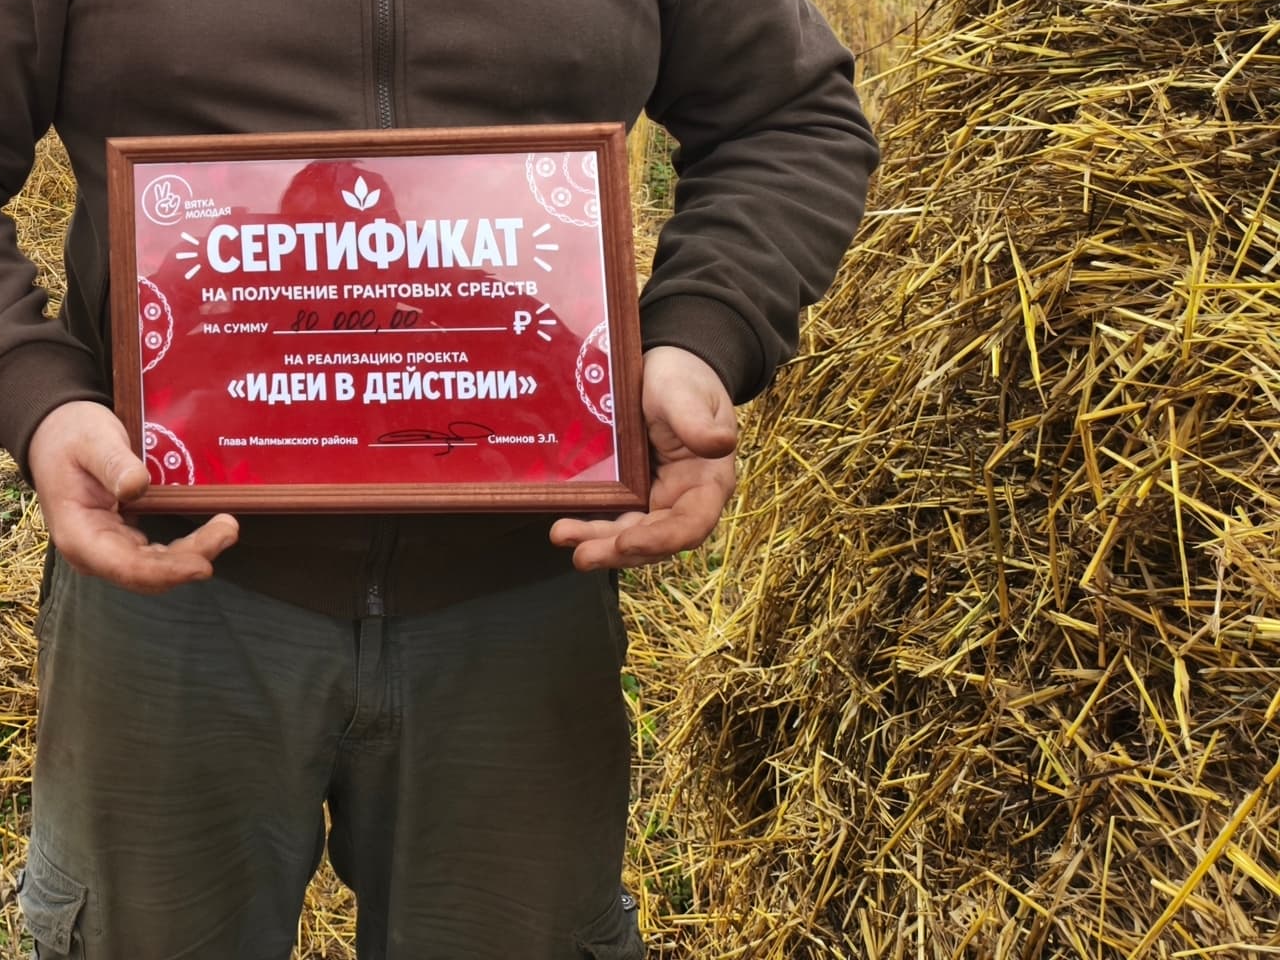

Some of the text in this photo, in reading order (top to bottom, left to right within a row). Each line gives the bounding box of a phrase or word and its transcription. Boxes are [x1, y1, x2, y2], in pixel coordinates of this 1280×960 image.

[184, 198, 215, 210] ВЯТКА
[185, 206, 232, 220] МОЛОДАЯ
[206, 218, 524, 273] СЕРТИФИКАТ
[201, 280, 538, 302] НА ПОЛУЧЕНИЕ ГРАНТОВЫХ СРЕДСТВ
[291, 309, 320, 331] 80
[203, 323, 221, 334] НА
[223, 322, 268, 334] СУММУ
[284, 351, 469, 366] НА РЕАЛИЗАЦИЮ ПРОЕКТА
[227, 366, 538, 405] «ИДЕИ В ДЕЙСТВИИ»
[218, 436, 247, 447] Глава
[249, 436, 319, 447] Малмыжского
[321, 435, 358, 447] района
[487, 433, 535, 444] Симонов
